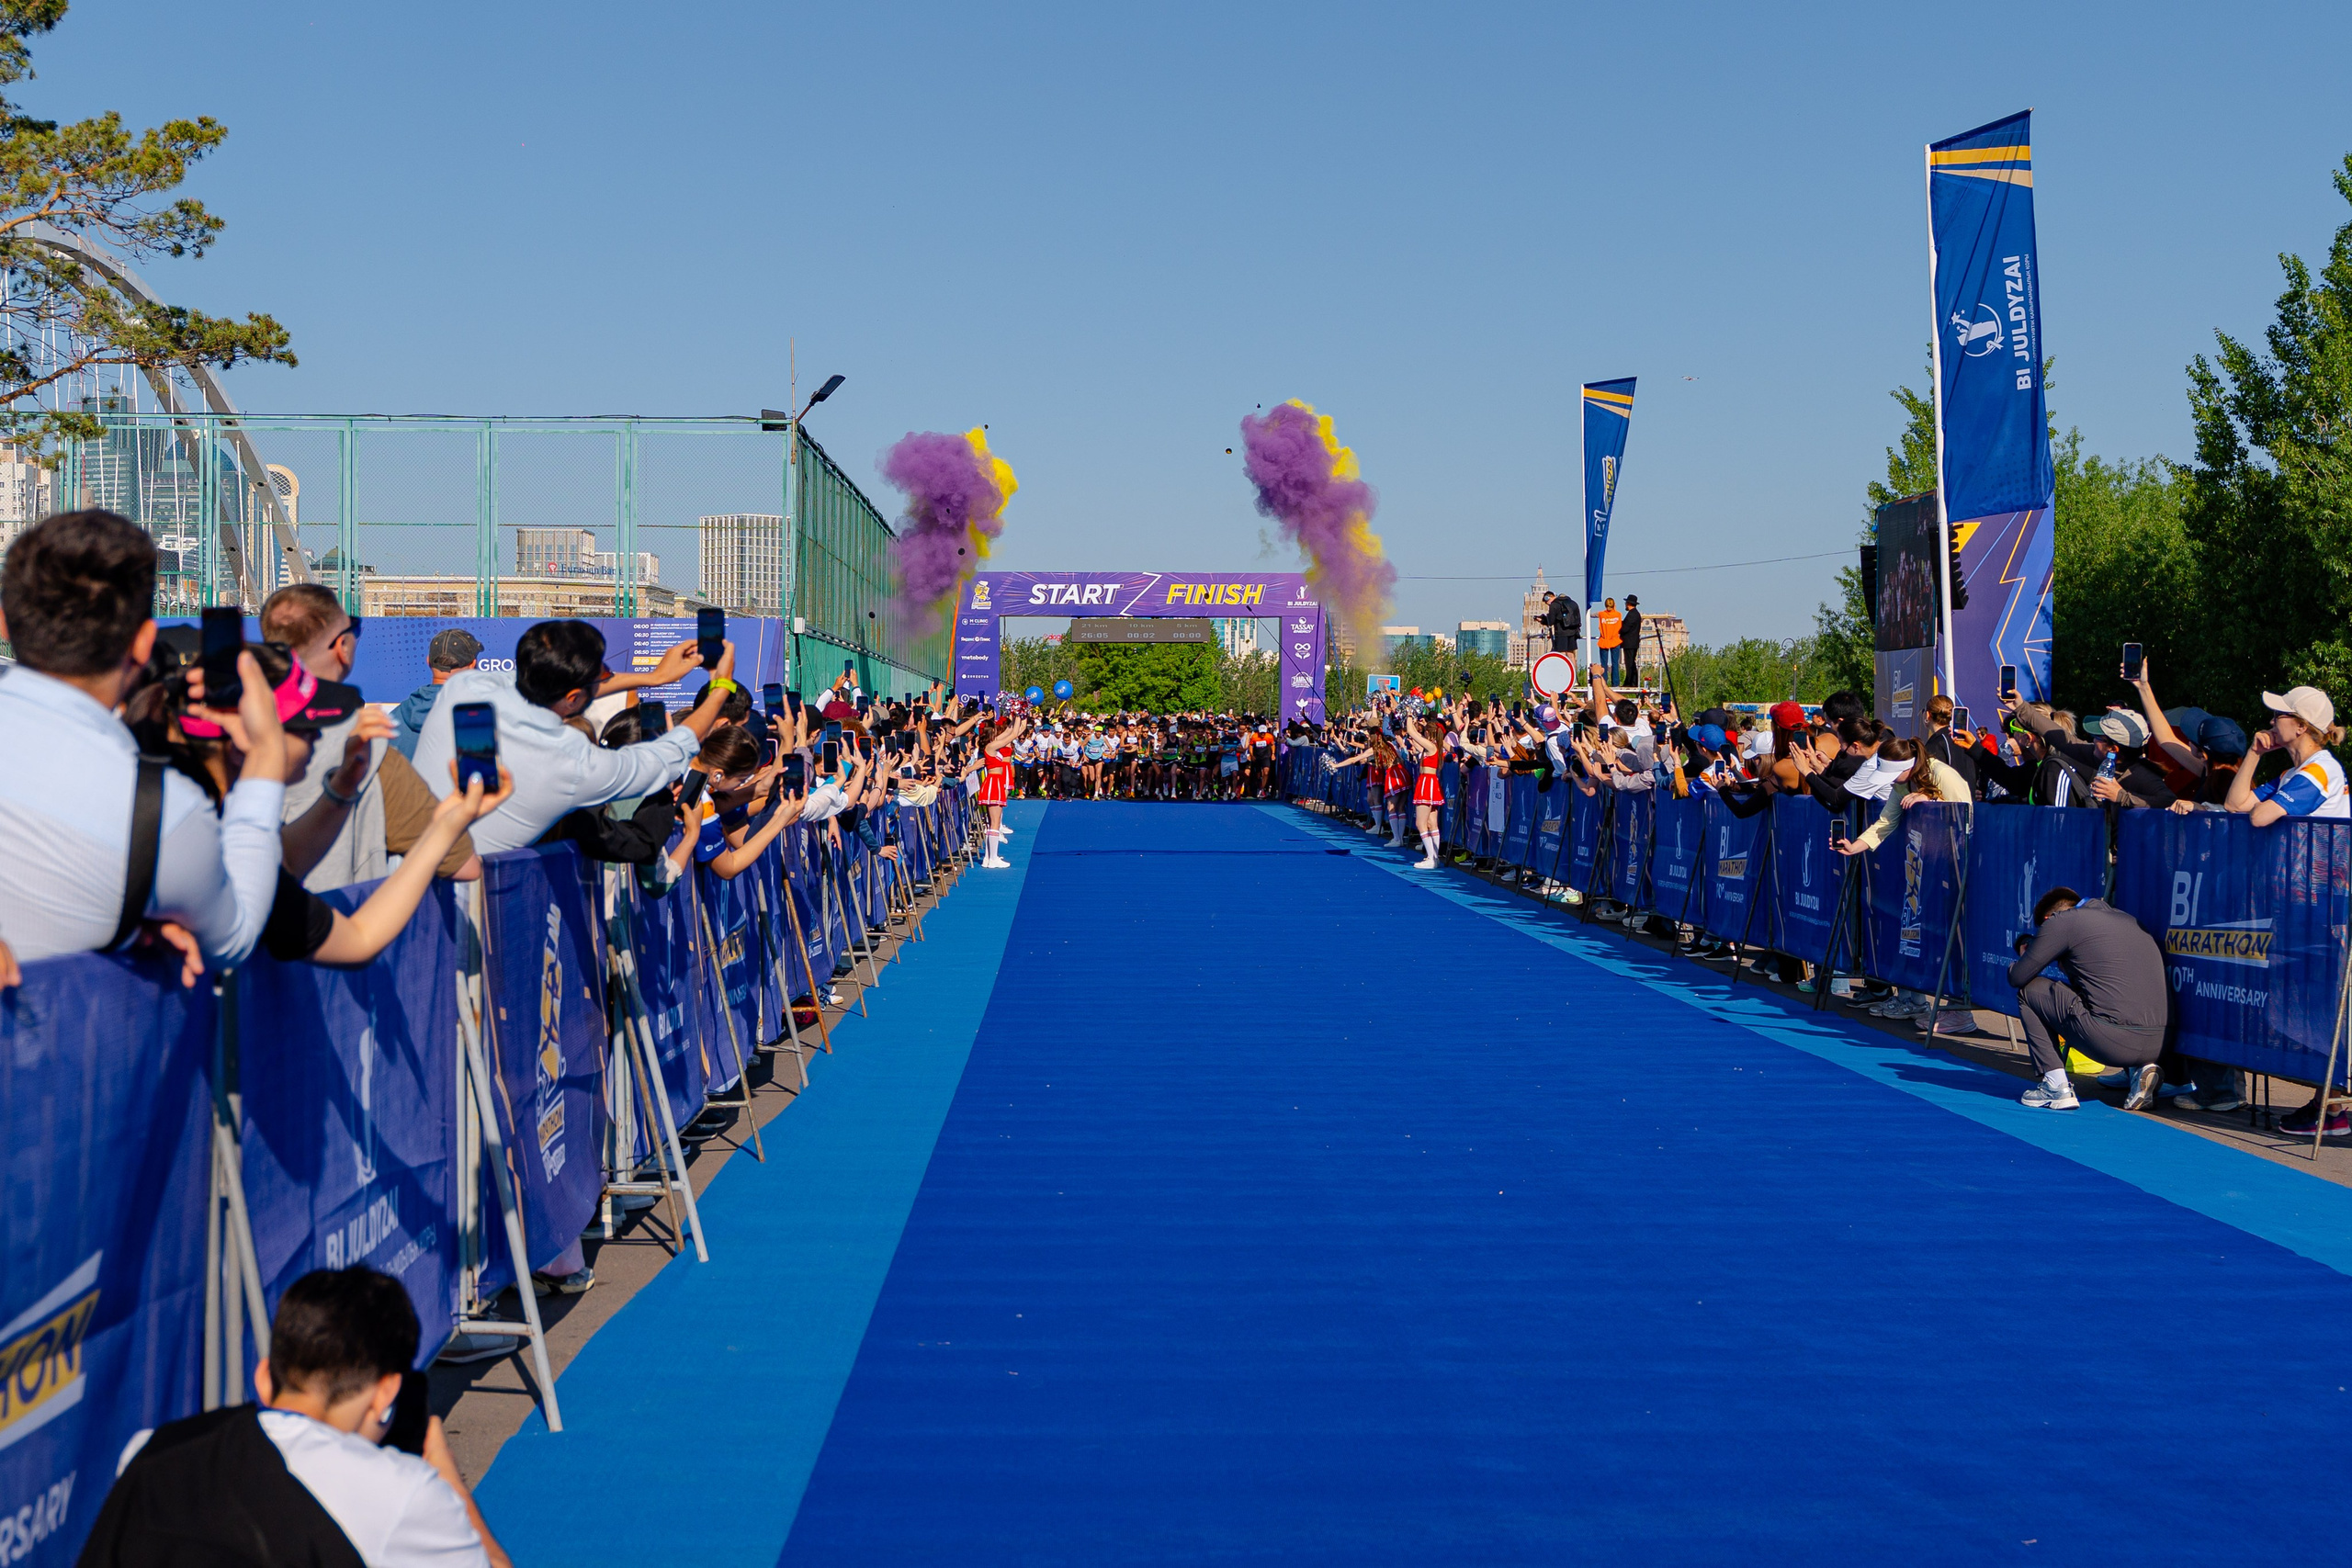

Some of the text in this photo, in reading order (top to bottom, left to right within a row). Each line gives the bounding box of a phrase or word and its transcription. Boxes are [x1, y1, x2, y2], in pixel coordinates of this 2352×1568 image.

[2002, 255, 2031, 390] BI JULDYZAI
[1028, 583, 1124, 605] START
[1165, 583, 1267, 605] FINISH
[478, 658, 516, 671] GRO
[1719, 826, 1730, 860] BI
[2170, 871, 2203, 926] BI
[2166, 930, 2270, 957] MARATHON
[2195, 980, 2268, 1009] ANNIVERSARY
